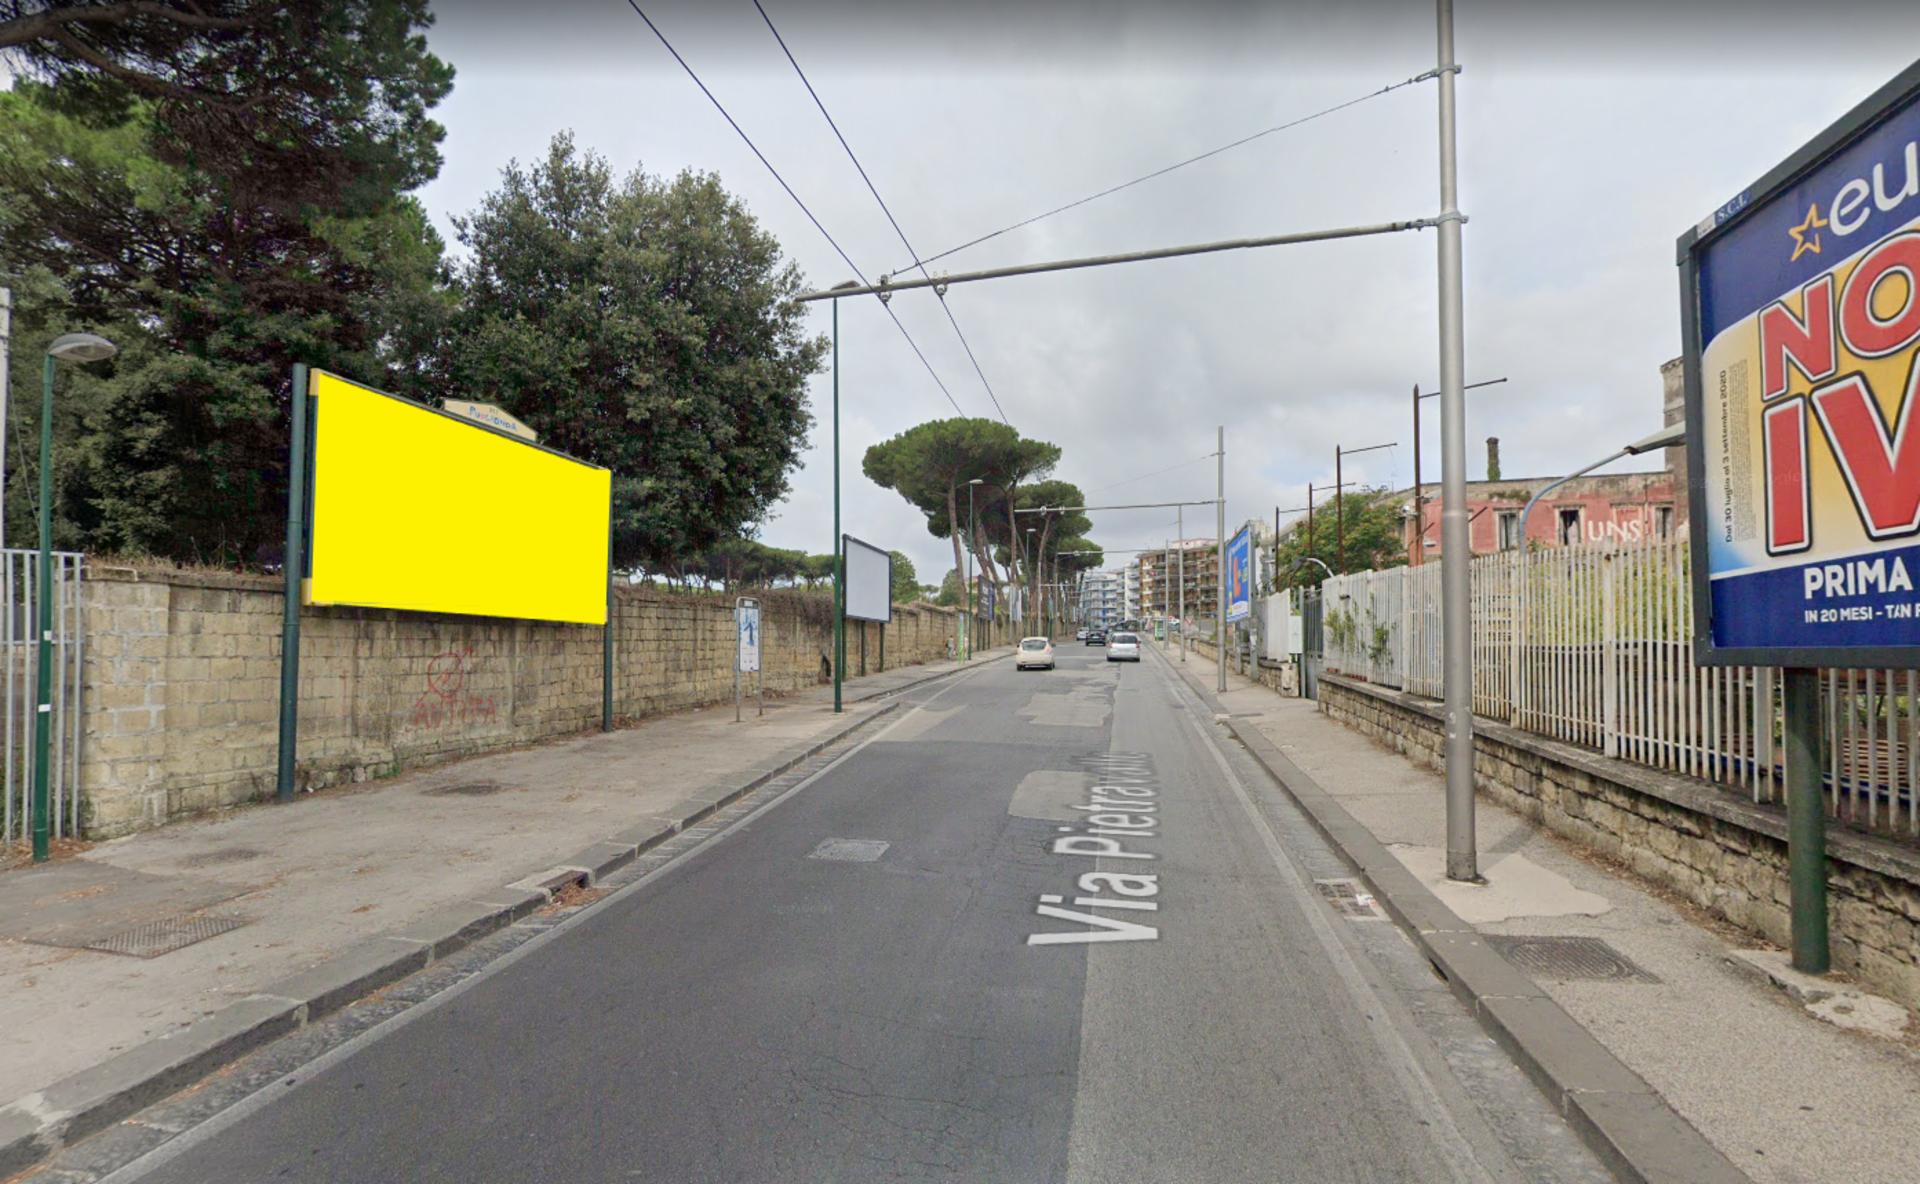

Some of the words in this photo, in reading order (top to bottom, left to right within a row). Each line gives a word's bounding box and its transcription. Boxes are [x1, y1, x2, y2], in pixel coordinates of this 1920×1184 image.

[1758, 229, 1920, 402] NO
[1720, 401, 1730, 454] settembre
[1723, 478, 1733, 506] luglio
[1725, 507, 1732, 523] 30
[1804, 556, 1913, 599] PRIMA
[1804, 610, 1818, 623] IN
[1820, 609, 1838, 622] 20
[1840, 606, 1873, 621] MESI
[1885, 603, 1912, 618] TAN
